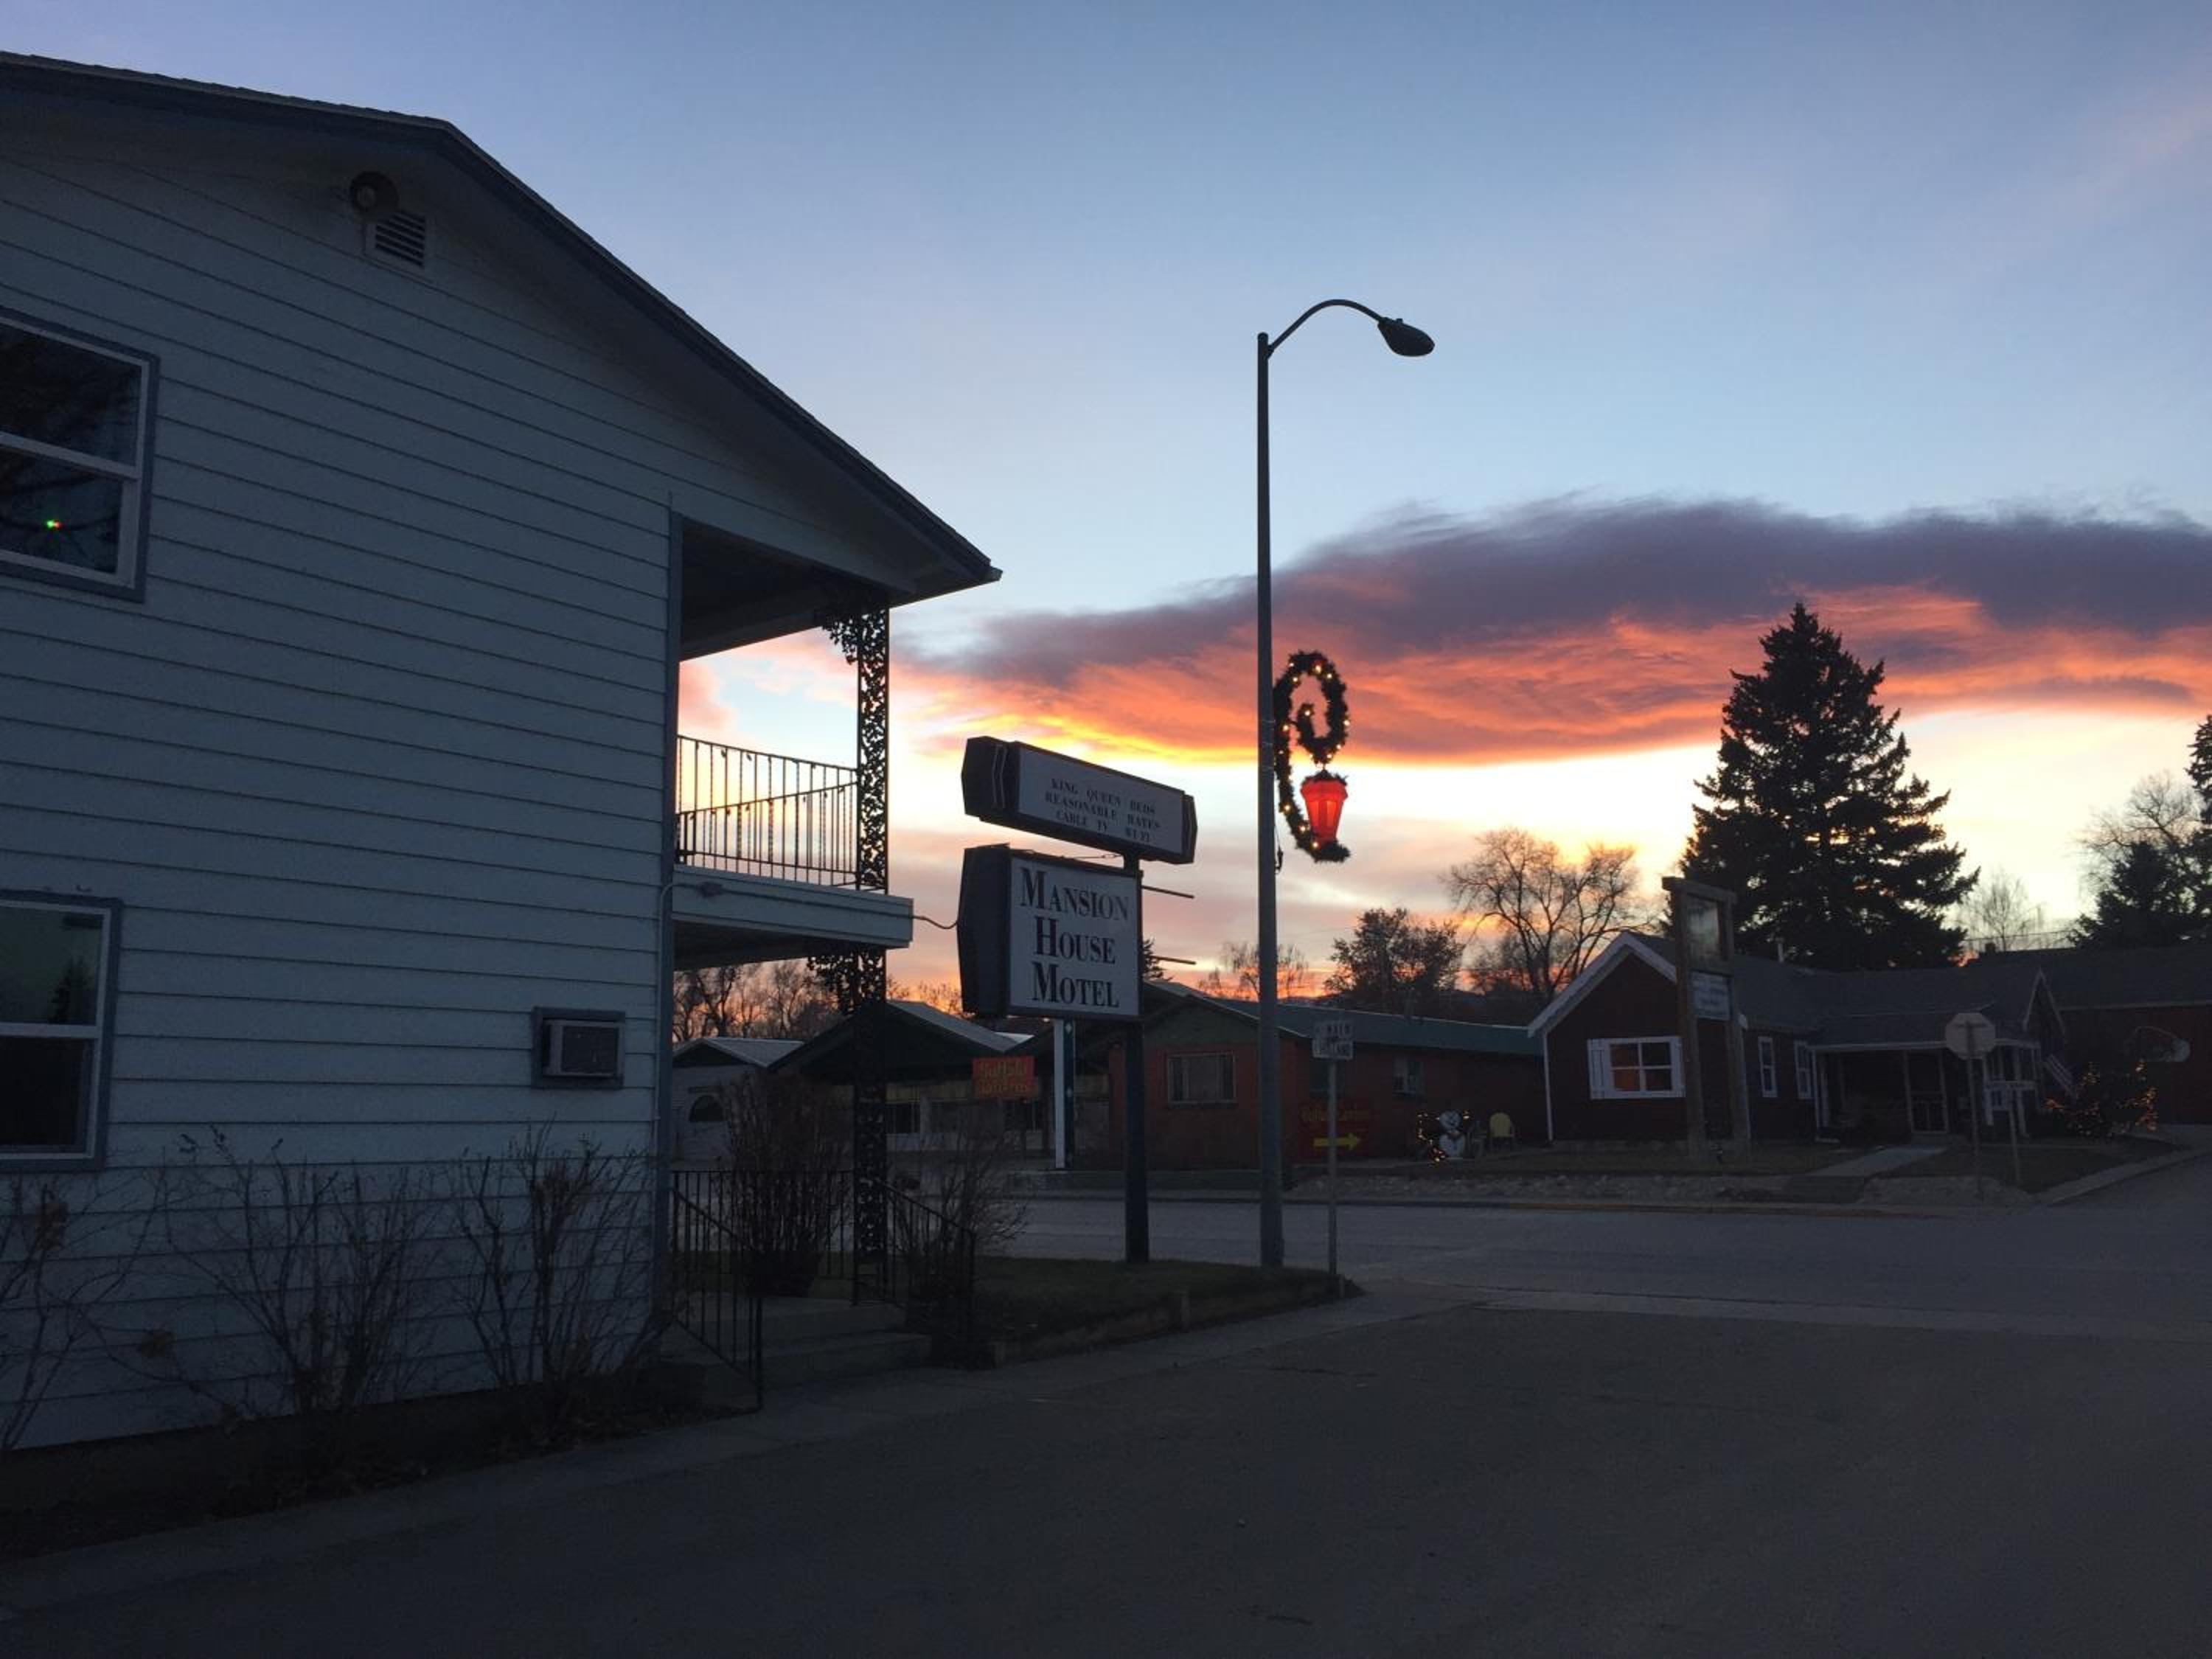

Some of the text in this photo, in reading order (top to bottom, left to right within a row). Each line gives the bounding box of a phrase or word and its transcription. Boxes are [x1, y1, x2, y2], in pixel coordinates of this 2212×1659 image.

[1045, 790, 1117, 819] REASONABLE
[1056, 810, 1087, 826] CABLE
[1097, 819, 1107, 832] TV
[1020, 866, 1129, 921] MANSION
[1034, 915, 1116, 964] HOUSE
[1032, 961, 1119, 1008] MOTEL
